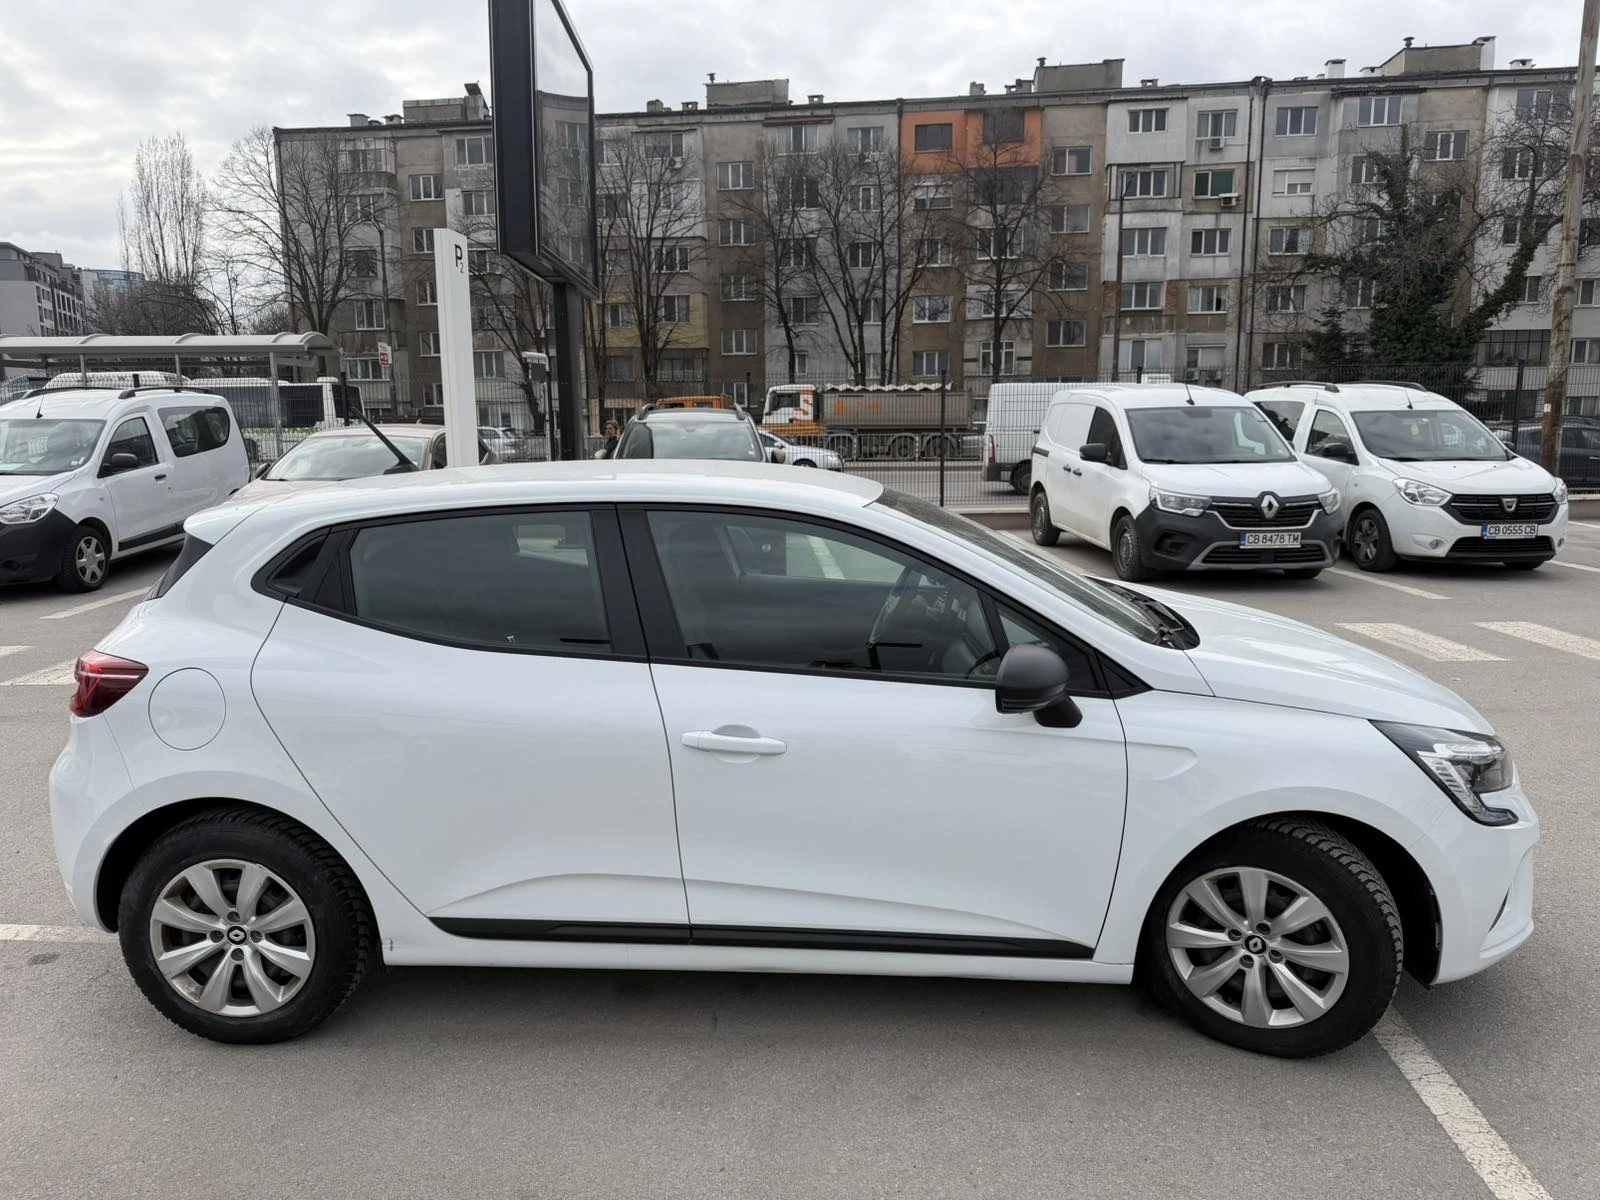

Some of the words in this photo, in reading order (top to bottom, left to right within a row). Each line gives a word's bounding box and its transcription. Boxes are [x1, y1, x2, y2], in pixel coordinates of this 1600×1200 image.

[1488, 525, 1500, 535] CB
[1502, 525, 1523, 535] 0555
[1524, 525, 1536, 535] CB
[1248, 534, 1260, 544] CB
[1262, 533, 1285, 544] 8478
[1287, 533, 1300, 544] TM
